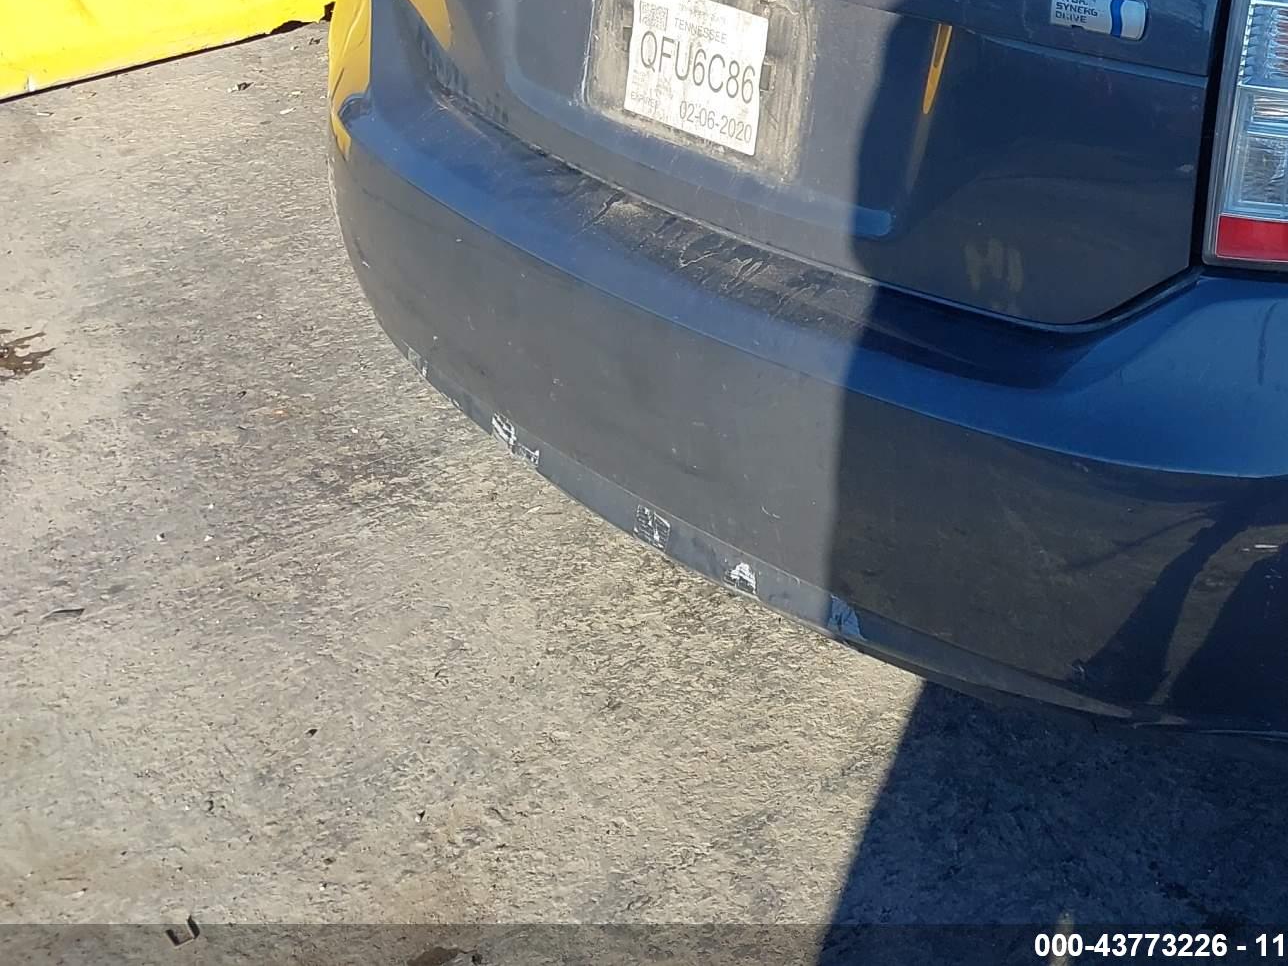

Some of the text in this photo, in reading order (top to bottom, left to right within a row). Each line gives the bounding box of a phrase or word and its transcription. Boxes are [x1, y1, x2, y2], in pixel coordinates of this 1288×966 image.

[1056, 2, 1103, 16] SYNERG
[674, 17, 728, 44] TENNESSEE
[640, 31, 756, 104] QFU6C86
[679, 100, 753, 143] 02-06-2020
